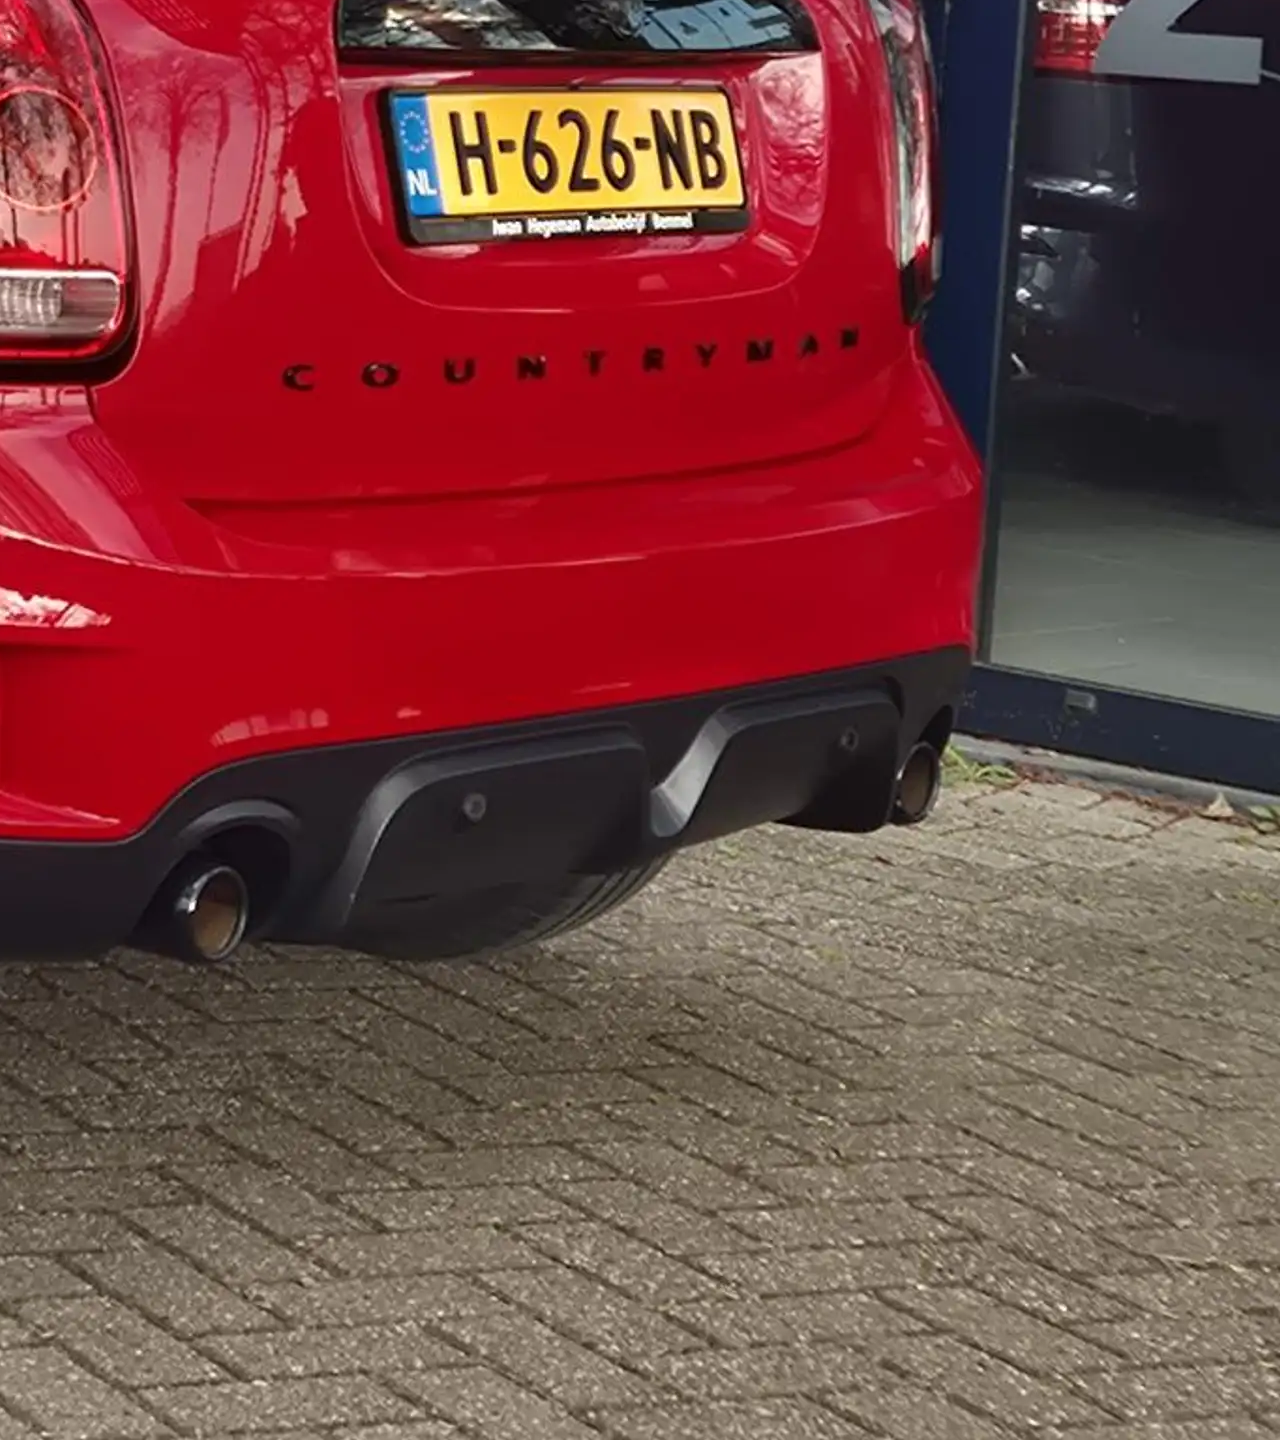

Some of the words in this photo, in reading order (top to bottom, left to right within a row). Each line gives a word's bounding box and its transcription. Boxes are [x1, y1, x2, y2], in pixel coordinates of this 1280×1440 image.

[407, 168, 437, 196] NL
[449, 109, 727, 196] H-626-NB
[281, 327, 860, 391] COUNTRYMAN
